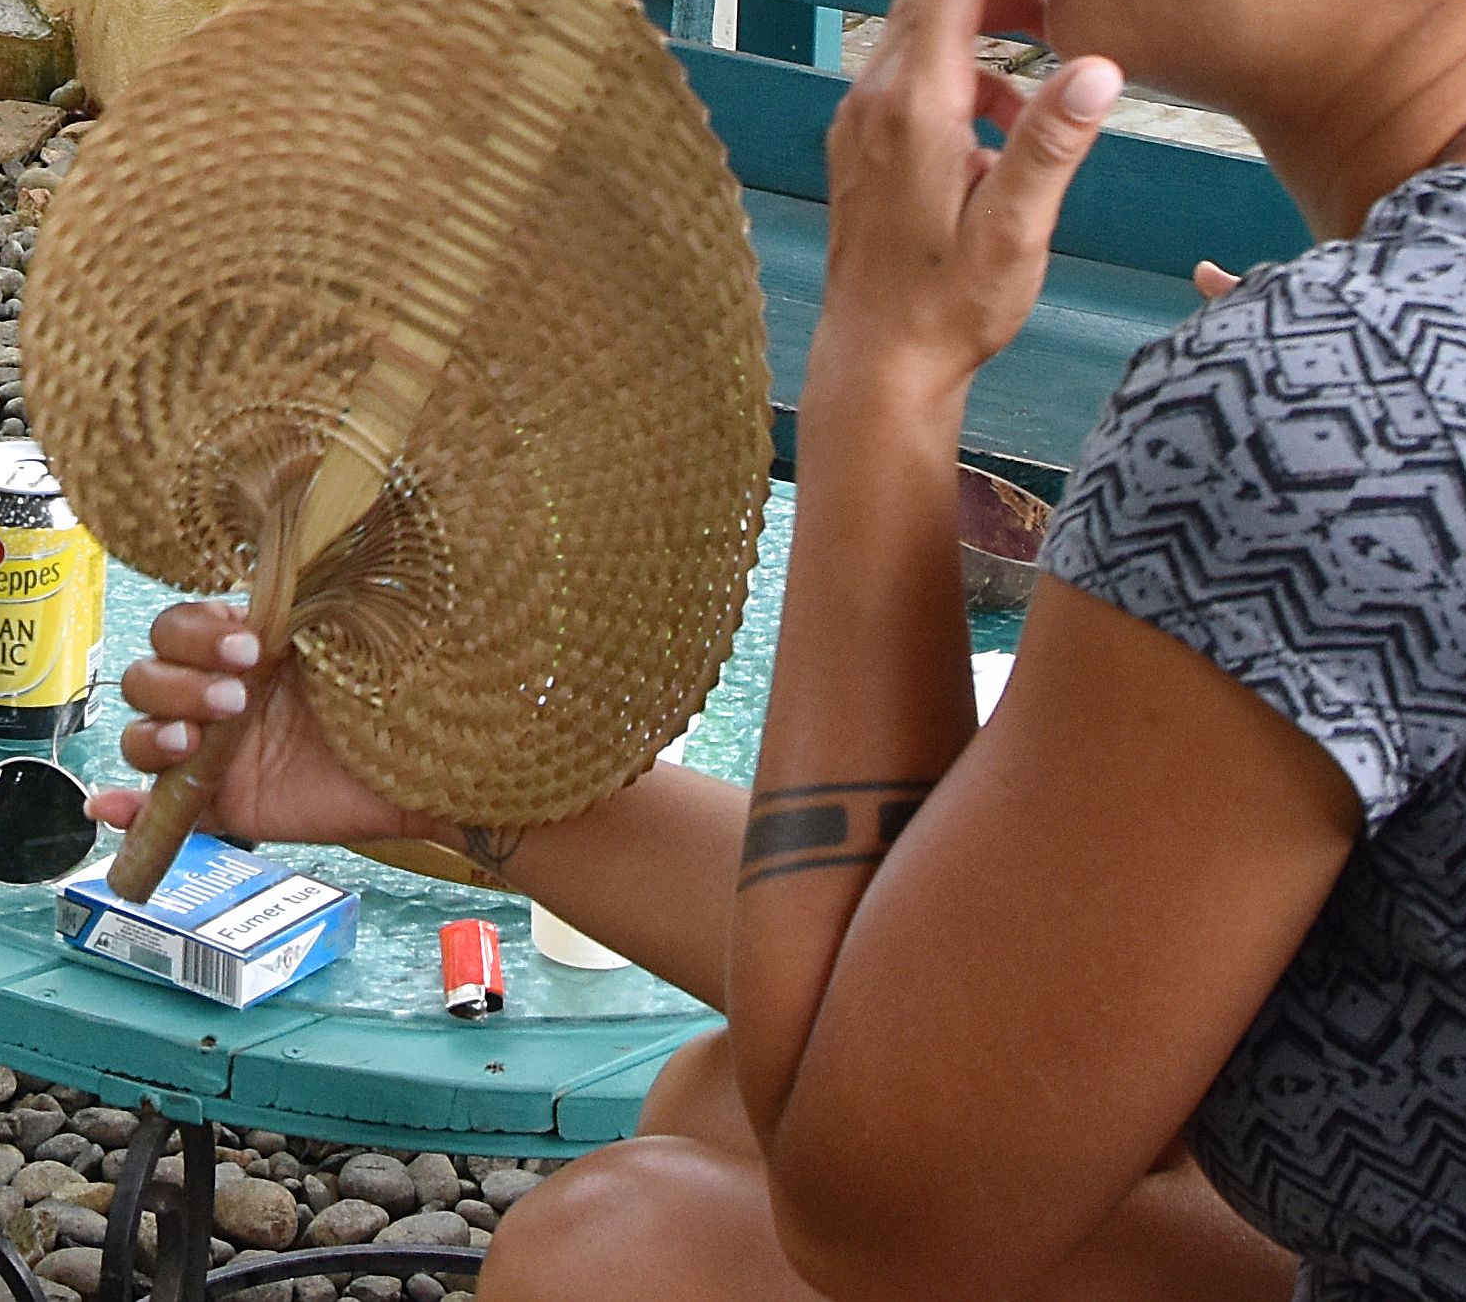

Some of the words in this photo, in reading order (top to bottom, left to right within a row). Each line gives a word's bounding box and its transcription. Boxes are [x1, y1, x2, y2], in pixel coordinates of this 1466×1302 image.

[146, 854, 265, 915] Winfield
[219, 901, 287, 941] Fumer
[282, 883, 323, 907] tue
